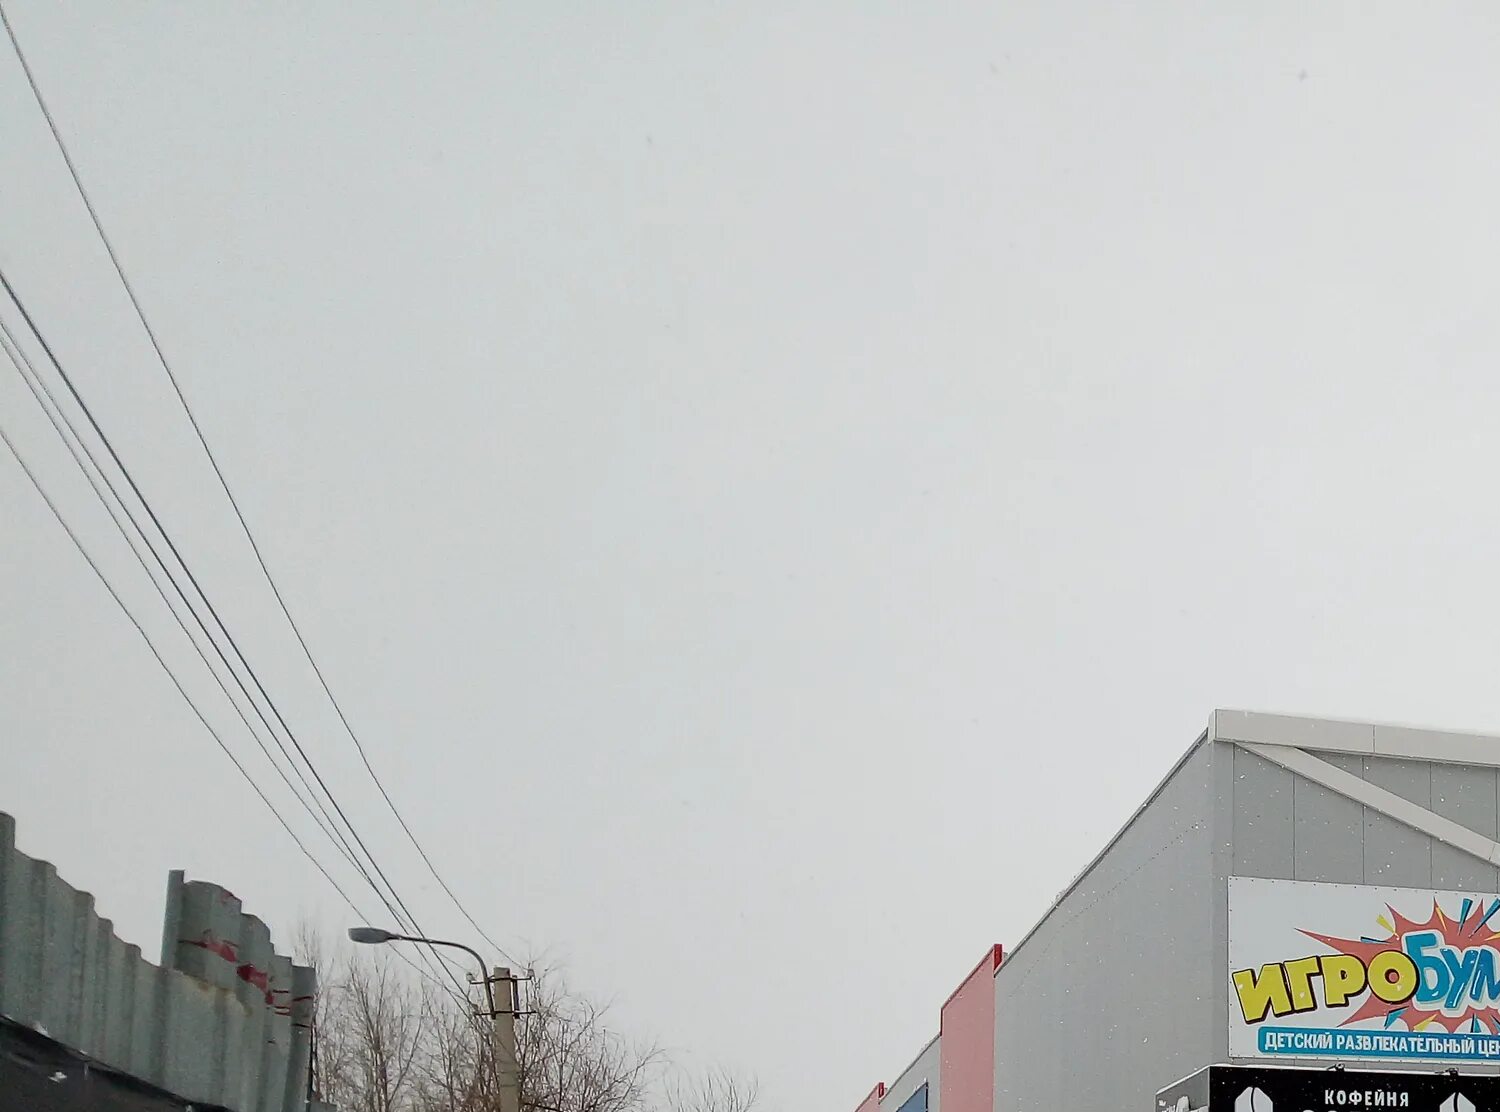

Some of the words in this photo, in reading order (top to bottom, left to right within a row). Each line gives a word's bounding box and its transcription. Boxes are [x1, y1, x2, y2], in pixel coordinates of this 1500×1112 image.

[1265, 1031, 1332, 1050] ДЕТСКИЙ
[1337, 1036, 1475, 1055] РАЗВЛЕКАТЕЛЬНЫЙ
[1324, 1089, 1410, 1107] КОФЕЙНЯ
